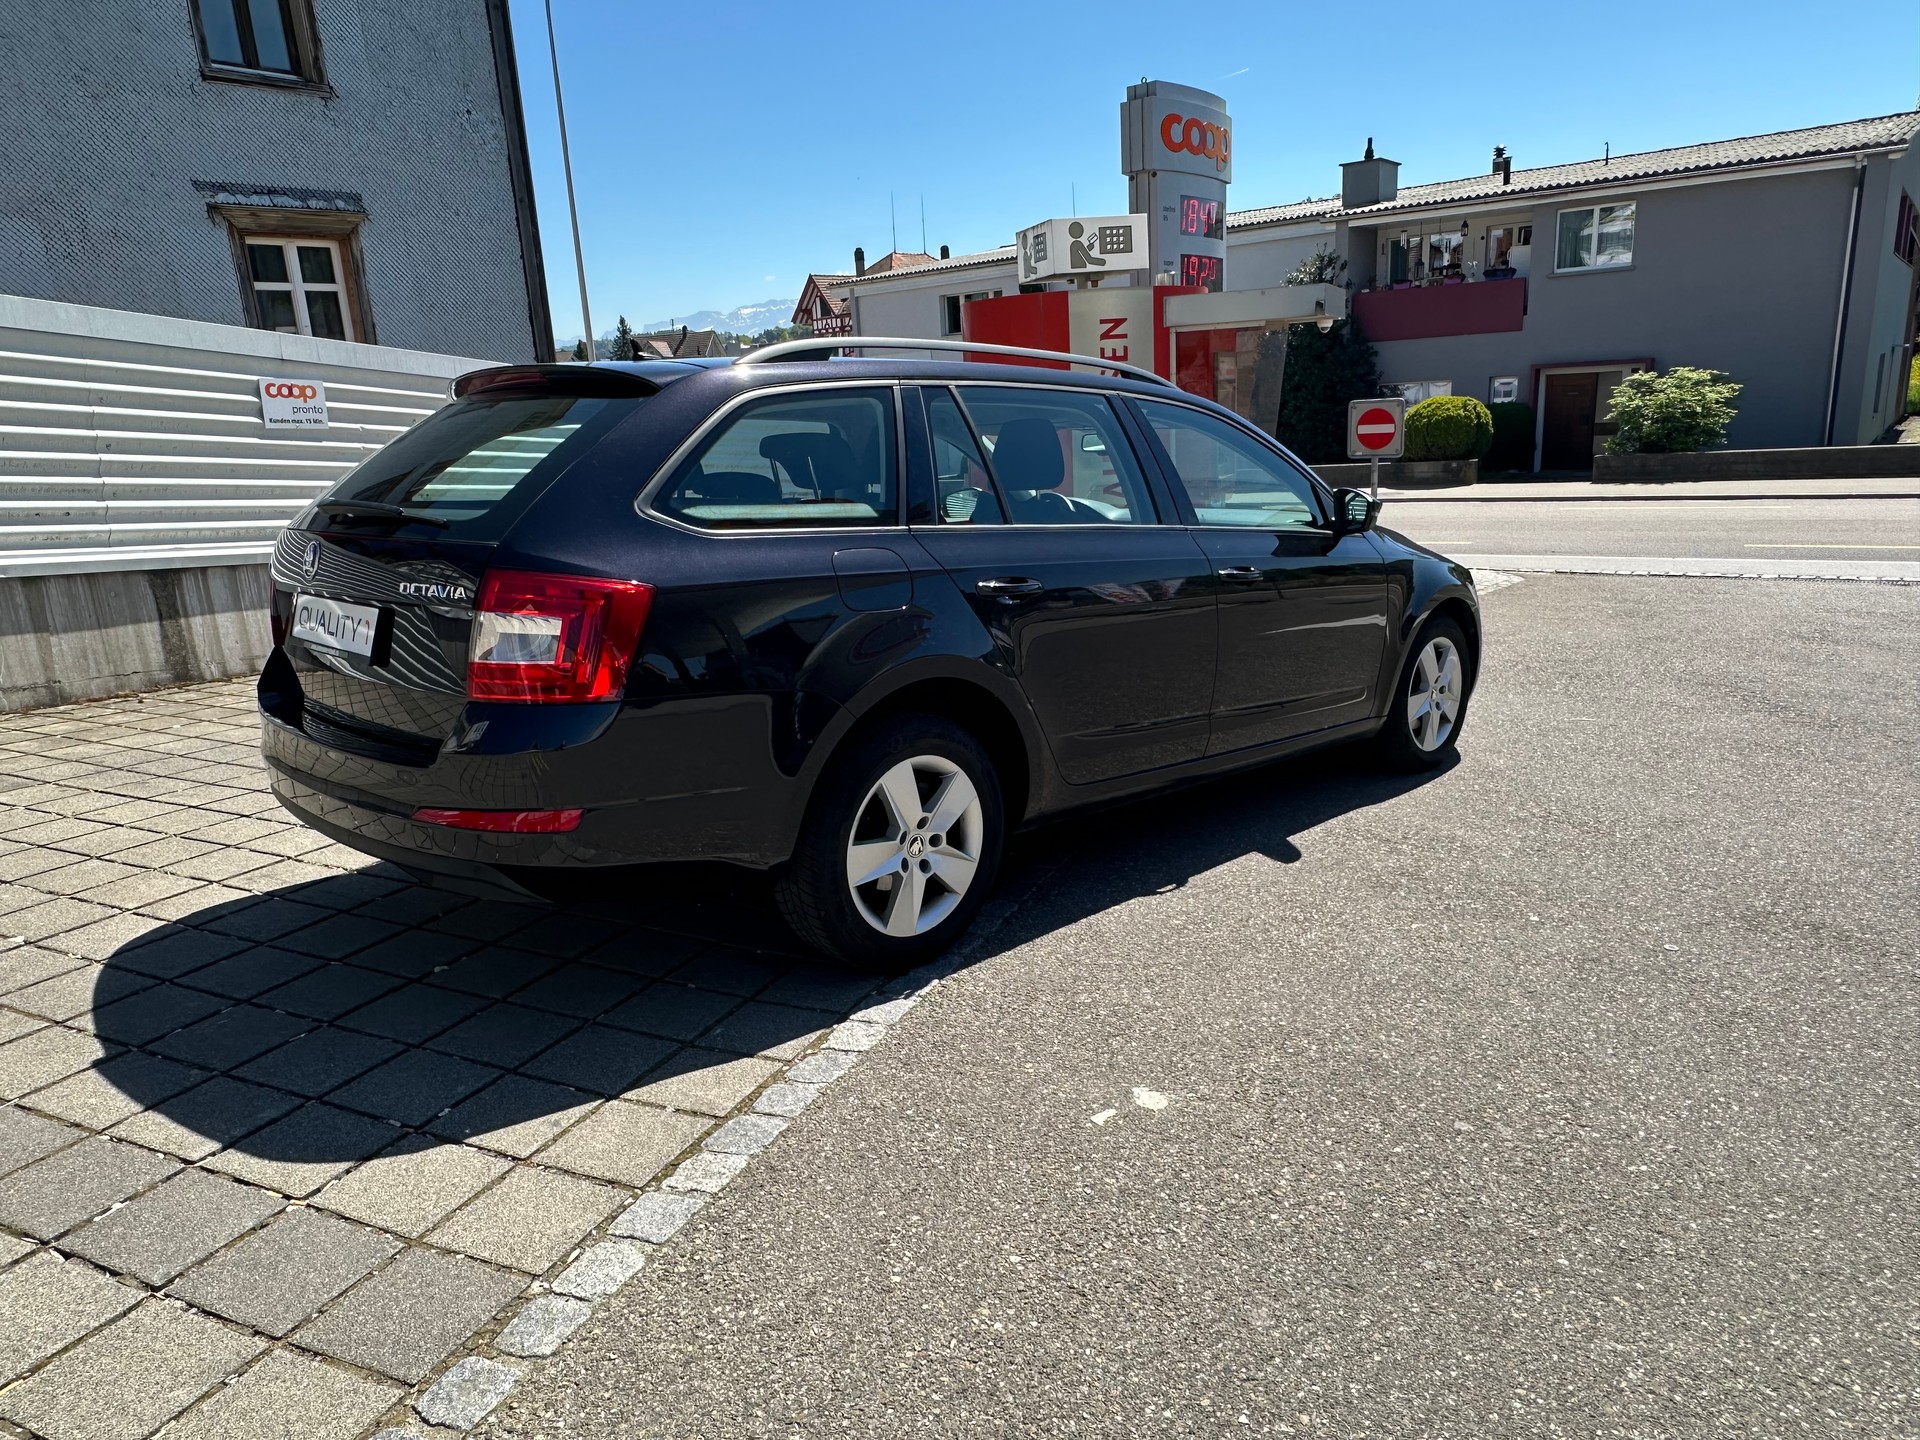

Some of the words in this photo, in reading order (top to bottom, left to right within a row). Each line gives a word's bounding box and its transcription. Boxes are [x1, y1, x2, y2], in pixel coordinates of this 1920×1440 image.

[1161, 113, 1230, 172] coop
[264, 382, 317, 403] coop
[292, 406, 324, 415] pronto
[400, 582, 467, 600] OCTAVIA
